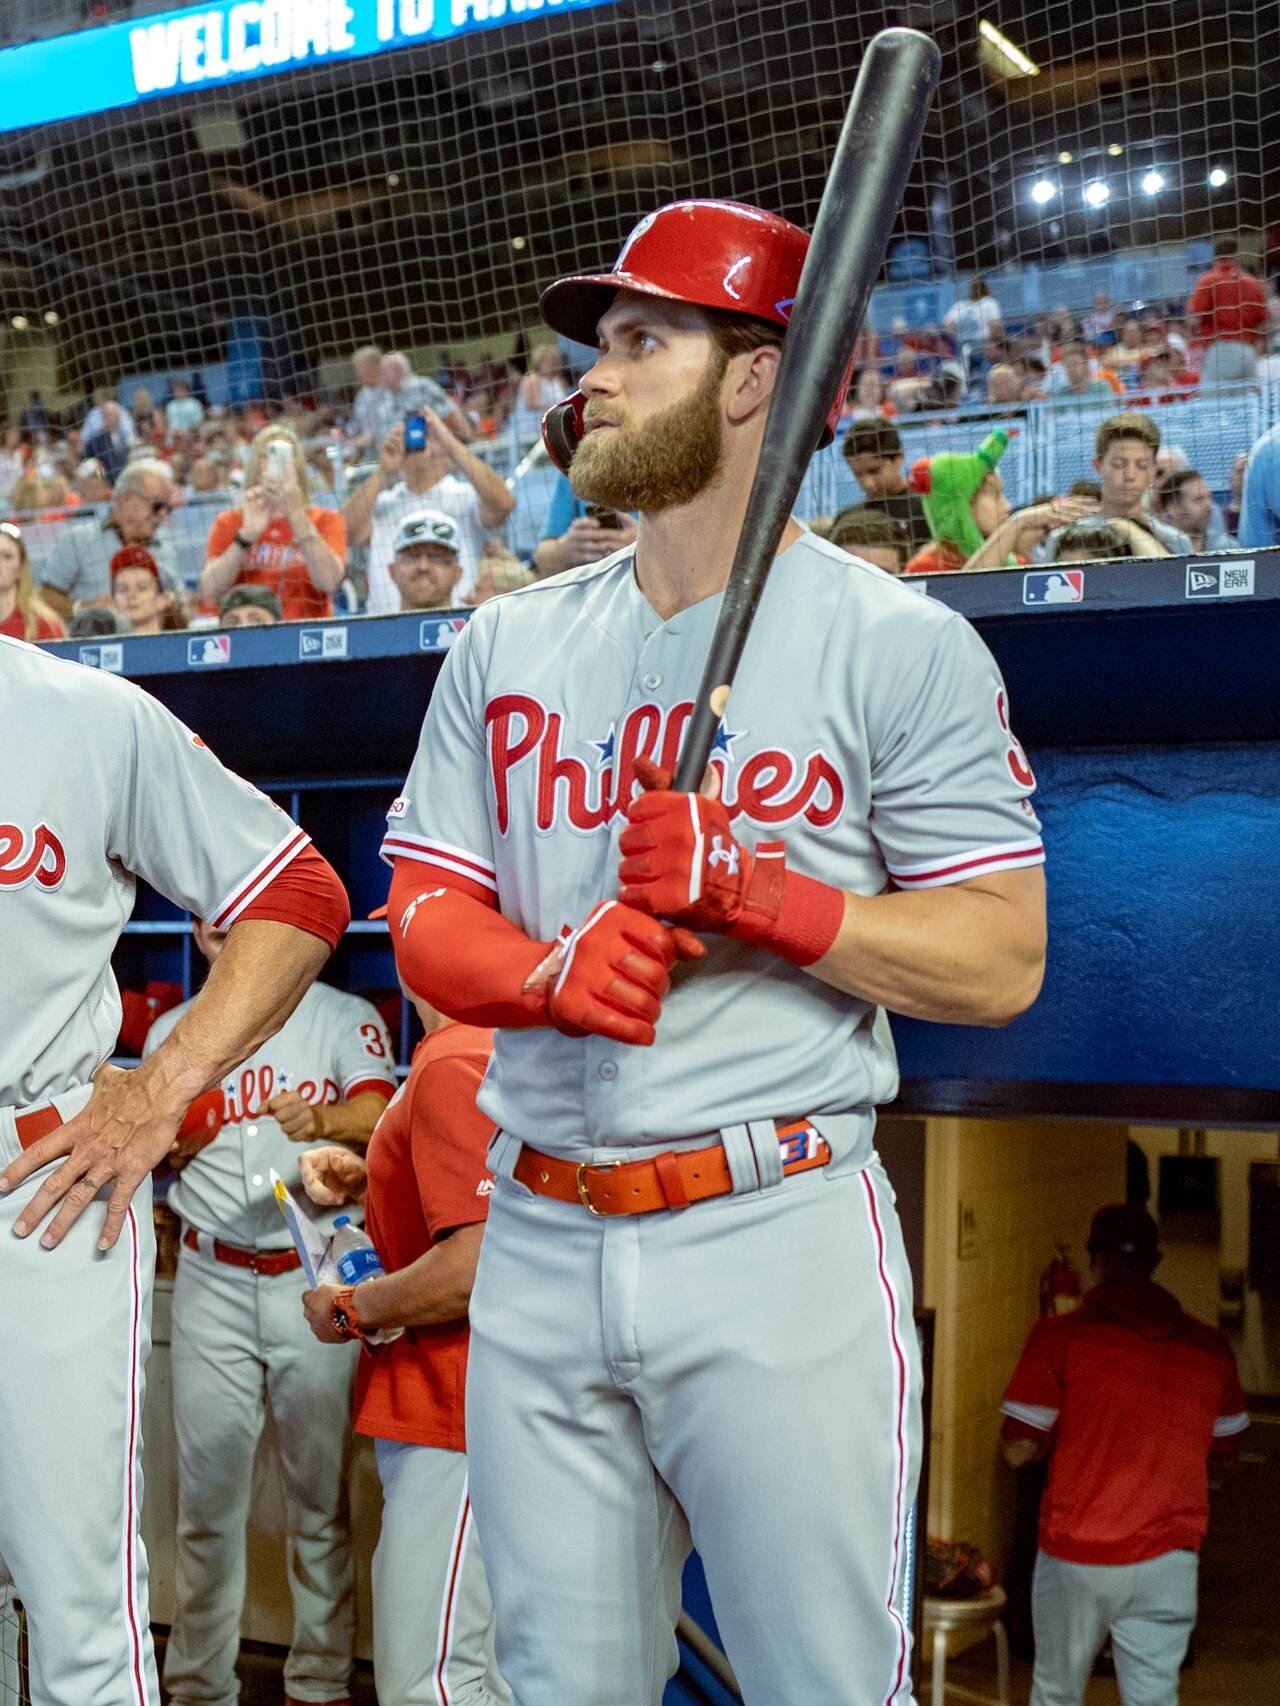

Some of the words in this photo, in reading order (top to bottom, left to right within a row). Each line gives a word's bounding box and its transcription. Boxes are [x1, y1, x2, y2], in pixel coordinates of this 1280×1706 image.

[130, 0, 354, 93] WELCOME
[1224, 568, 1249, 579] NEW
[1224, 578, 1249, 588] ERA
